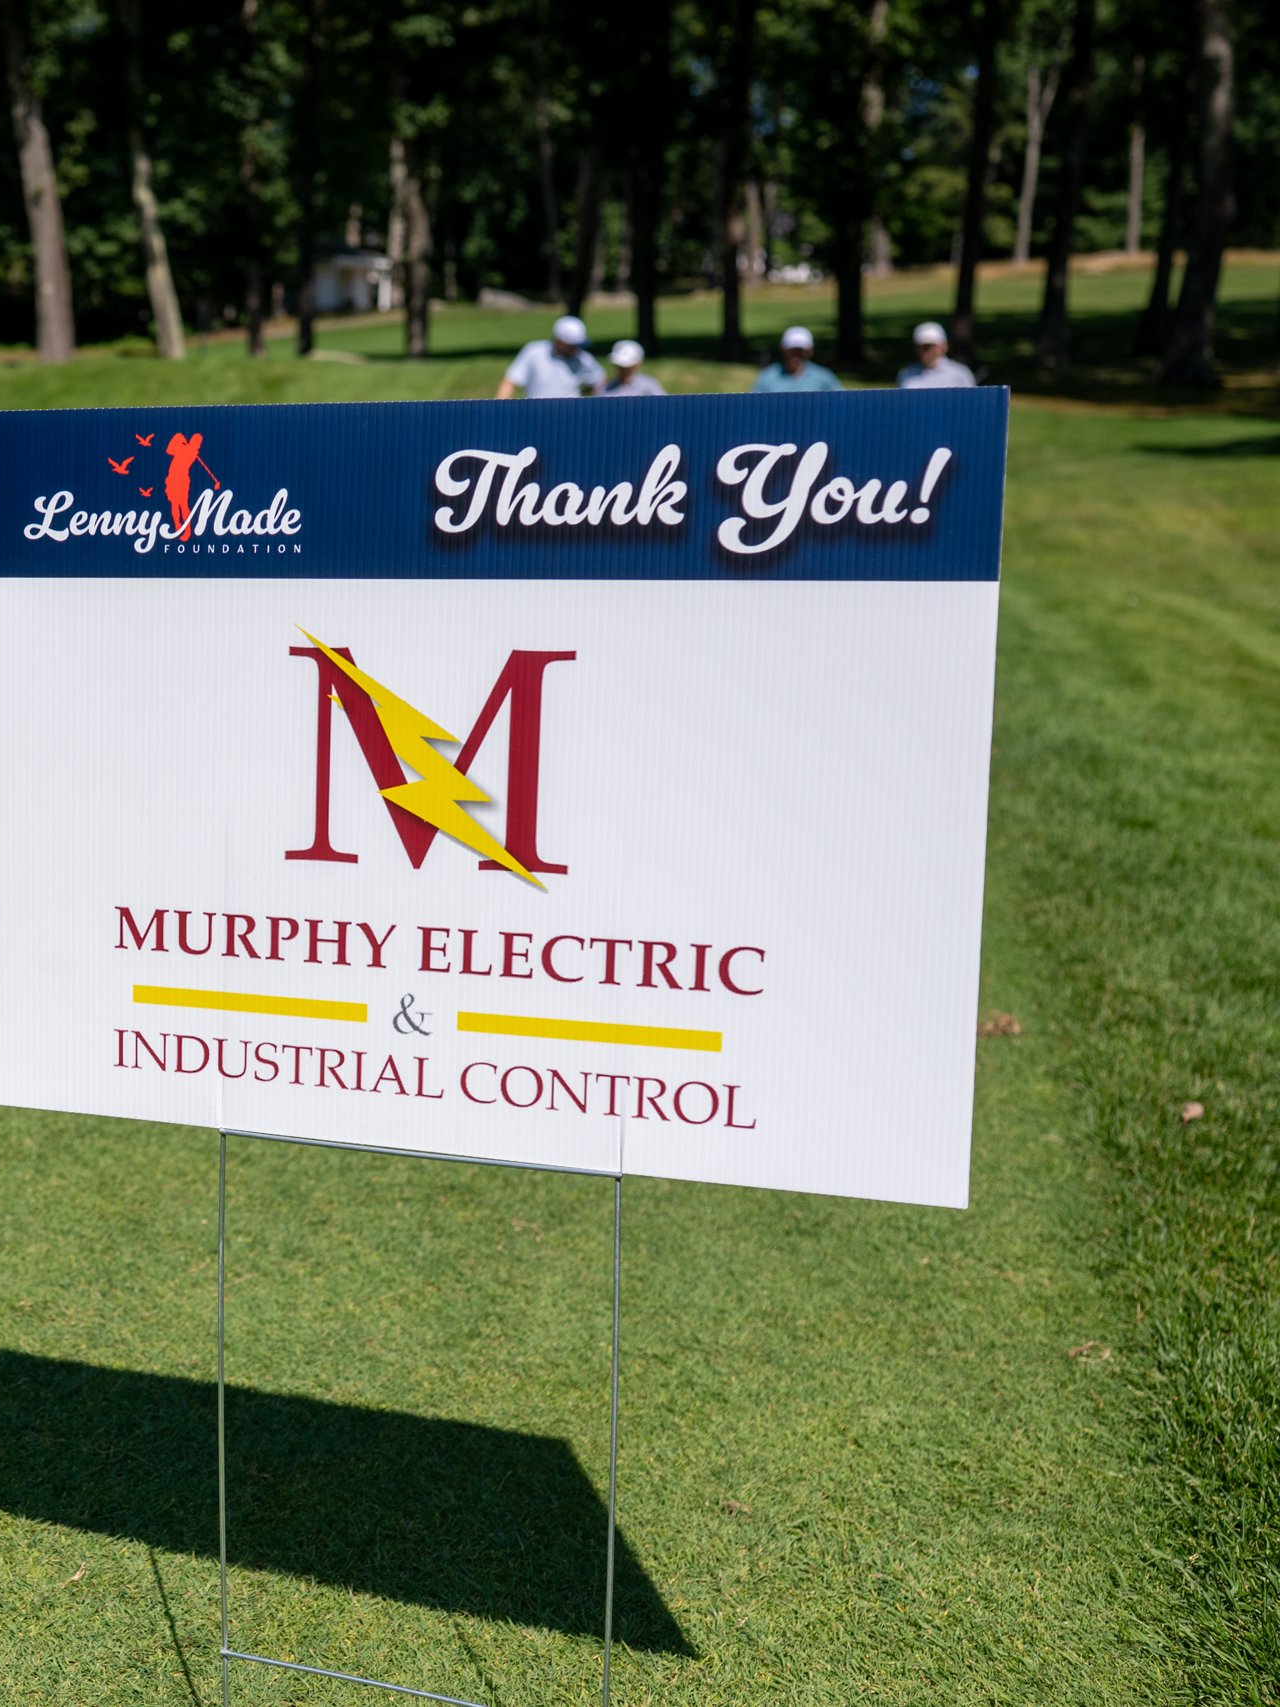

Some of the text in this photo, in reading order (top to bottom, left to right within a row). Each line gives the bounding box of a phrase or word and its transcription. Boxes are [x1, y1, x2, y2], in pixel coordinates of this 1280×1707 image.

[23, 488, 302, 554] Lenny Made
[433, 440, 952, 554] Thank You!
[163, 543, 302, 554] FOUNDATION
[114, 906, 766, 996] MURPHY ELECTRIC
[392, 993, 433, 1038] &
[113, 1028, 758, 1130] INDUSTRIAL CONTROL
